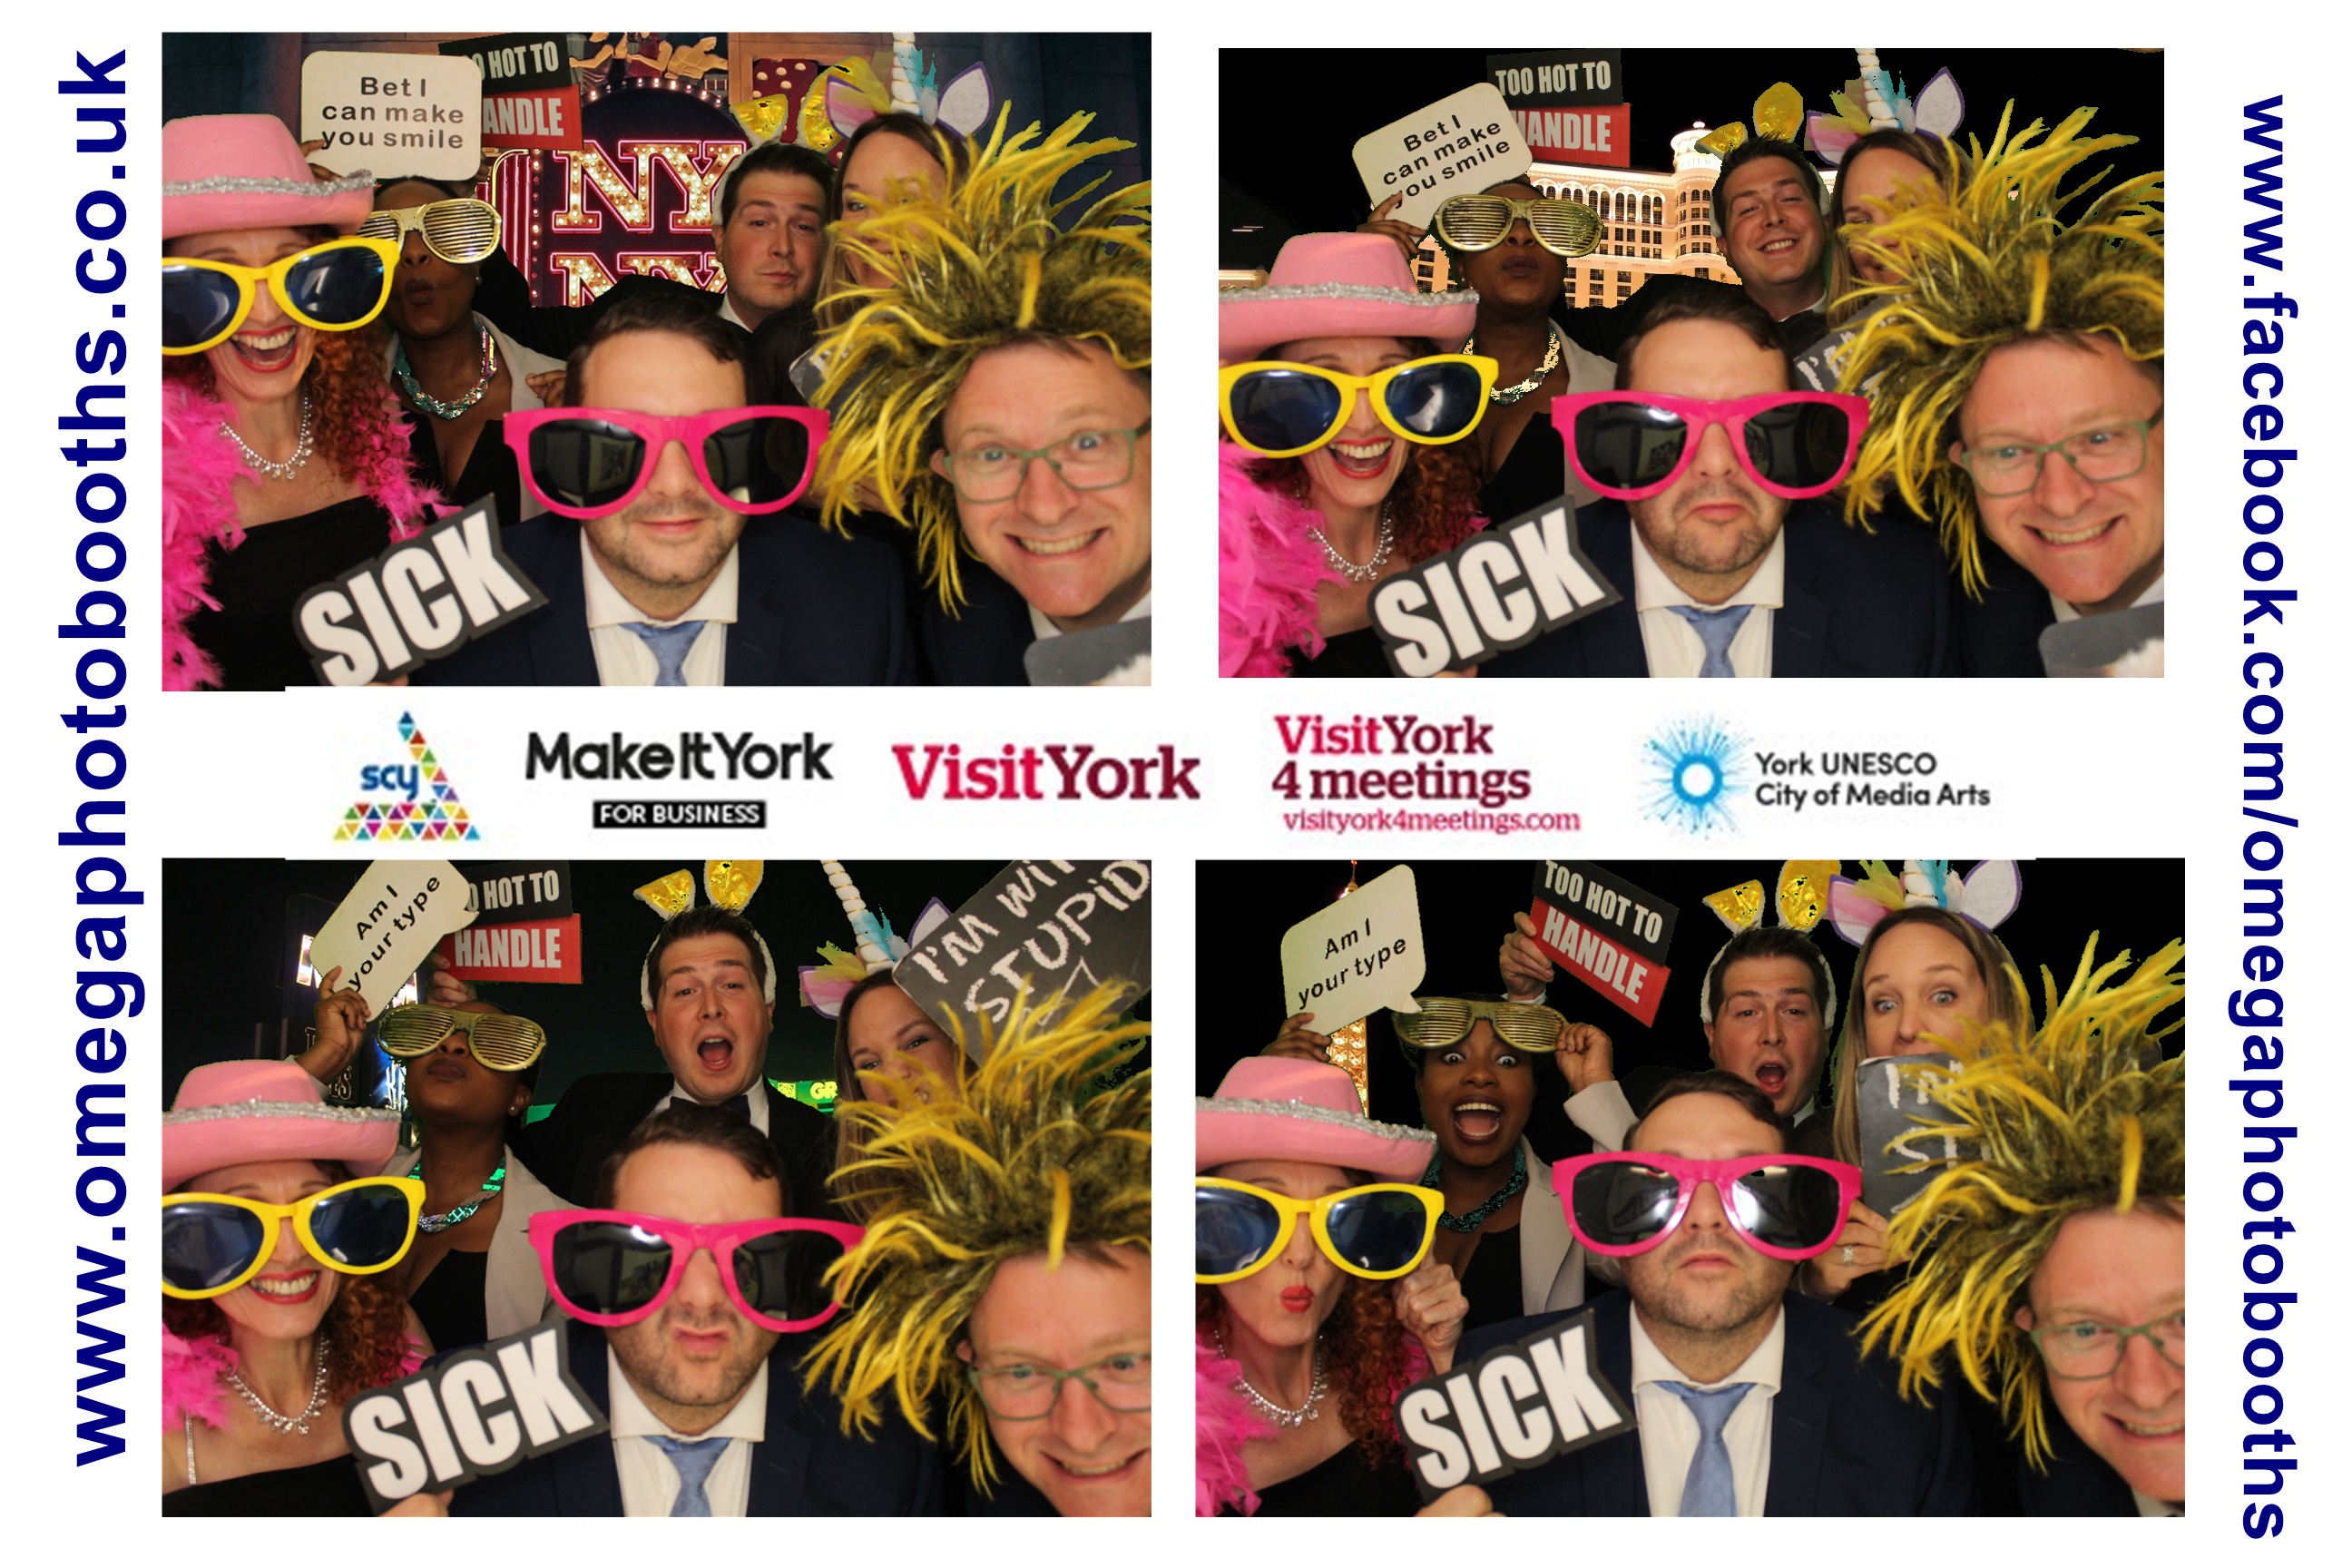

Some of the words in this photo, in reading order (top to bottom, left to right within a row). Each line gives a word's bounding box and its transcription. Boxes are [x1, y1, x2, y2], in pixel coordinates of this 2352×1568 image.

[361, 76, 411, 97] Bet
[420, 78, 426, 97] I
[487, 46, 526, 78] HOT
[530, 41, 559, 73] TO
[1495, 67, 1534, 96] TOO
[1538, 64, 1579, 93] HOT
[1583, 60, 1612, 91] TO
[321, 131, 374, 150] you
[383, 129, 463, 149] smile
[322, 105, 376, 121] can
[386, 103, 464, 123] make
[482, 98, 564, 136] ANDLE
[1403, 122, 1449, 152] Bet
[1452, 114, 1461, 129] I
[1383, 156, 1428, 185] can
[1434, 122, 1501, 161] make
[1442, 141, 1510, 180] smile
[553, 140, 747, 234] NY
[299, 510, 532, 686] SICK
[1374, 506, 1606, 678] SICK
[357, 900, 388, 940] Am
[387, 884, 397, 897] I
[483, 875, 525, 909] HOT
[529, 869, 559, 904] TO
[1544, 859, 1584, 903] TOO
[1585, 880, 1632, 927] HOT
[1633, 904, 1663, 944] TO
[348, 932, 392, 993] your
[393, 877, 440, 931] type
[455, 928, 562, 968] HANDLE
[911, 914, 1000, 985] I'M
[1325, 929, 1358, 959] Am
[1365, 918, 1370, 936] I
[1542, 906, 1649, 1004] HANDLE
[1298, 968, 1348, 1010] your
[1355, 939, 1406, 976] type
[349, 1328, 595, 1499] SICK
[1399, 1325, 1622, 1488] SICK
